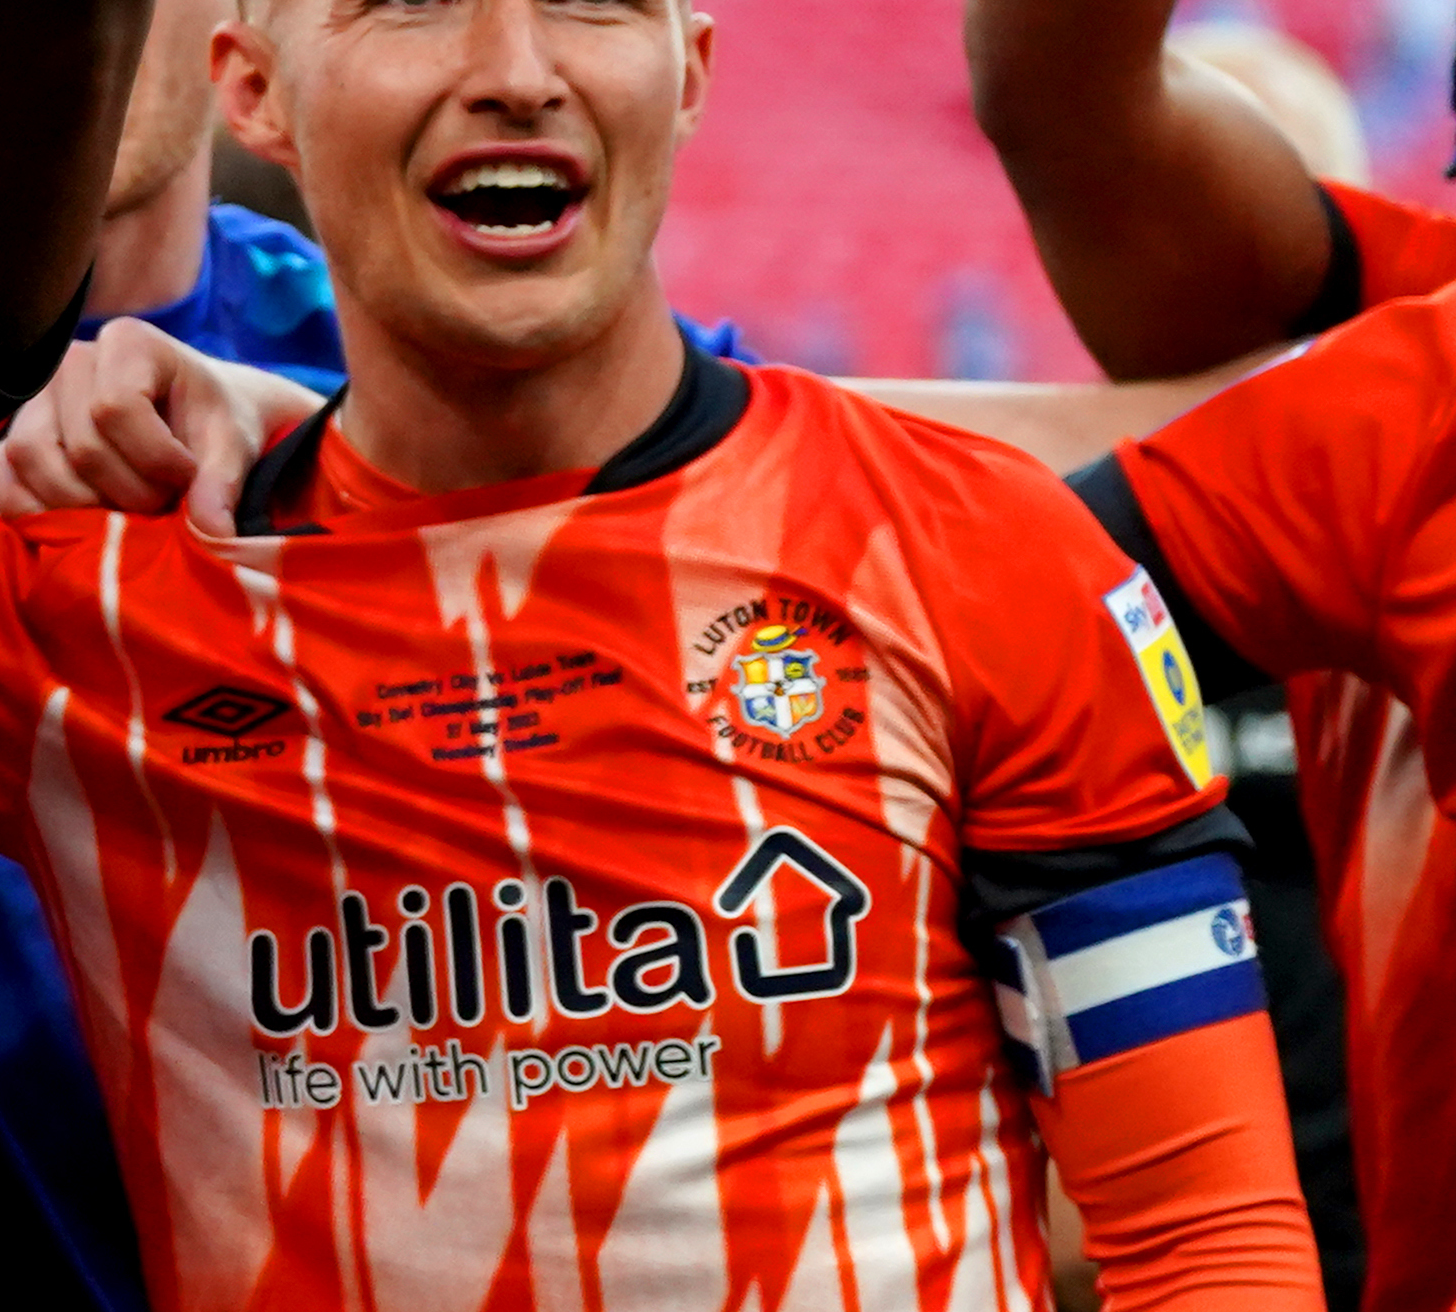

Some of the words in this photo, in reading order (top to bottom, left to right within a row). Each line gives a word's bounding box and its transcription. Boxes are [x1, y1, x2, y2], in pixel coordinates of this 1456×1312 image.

[694, 598, 769, 656] LUTON
[779, 598, 853, 647] TOWN
[181, 739, 286, 766] umbro
[706, 715, 814, 764] FOOTBALL
[815, 707, 865, 754] CLUB
[246, 876, 715, 1038] utilita
[255, 1051, 342, 1109] life
[358, 1040, 489, 1105] with
[508, 1034, 721, 1109] power
